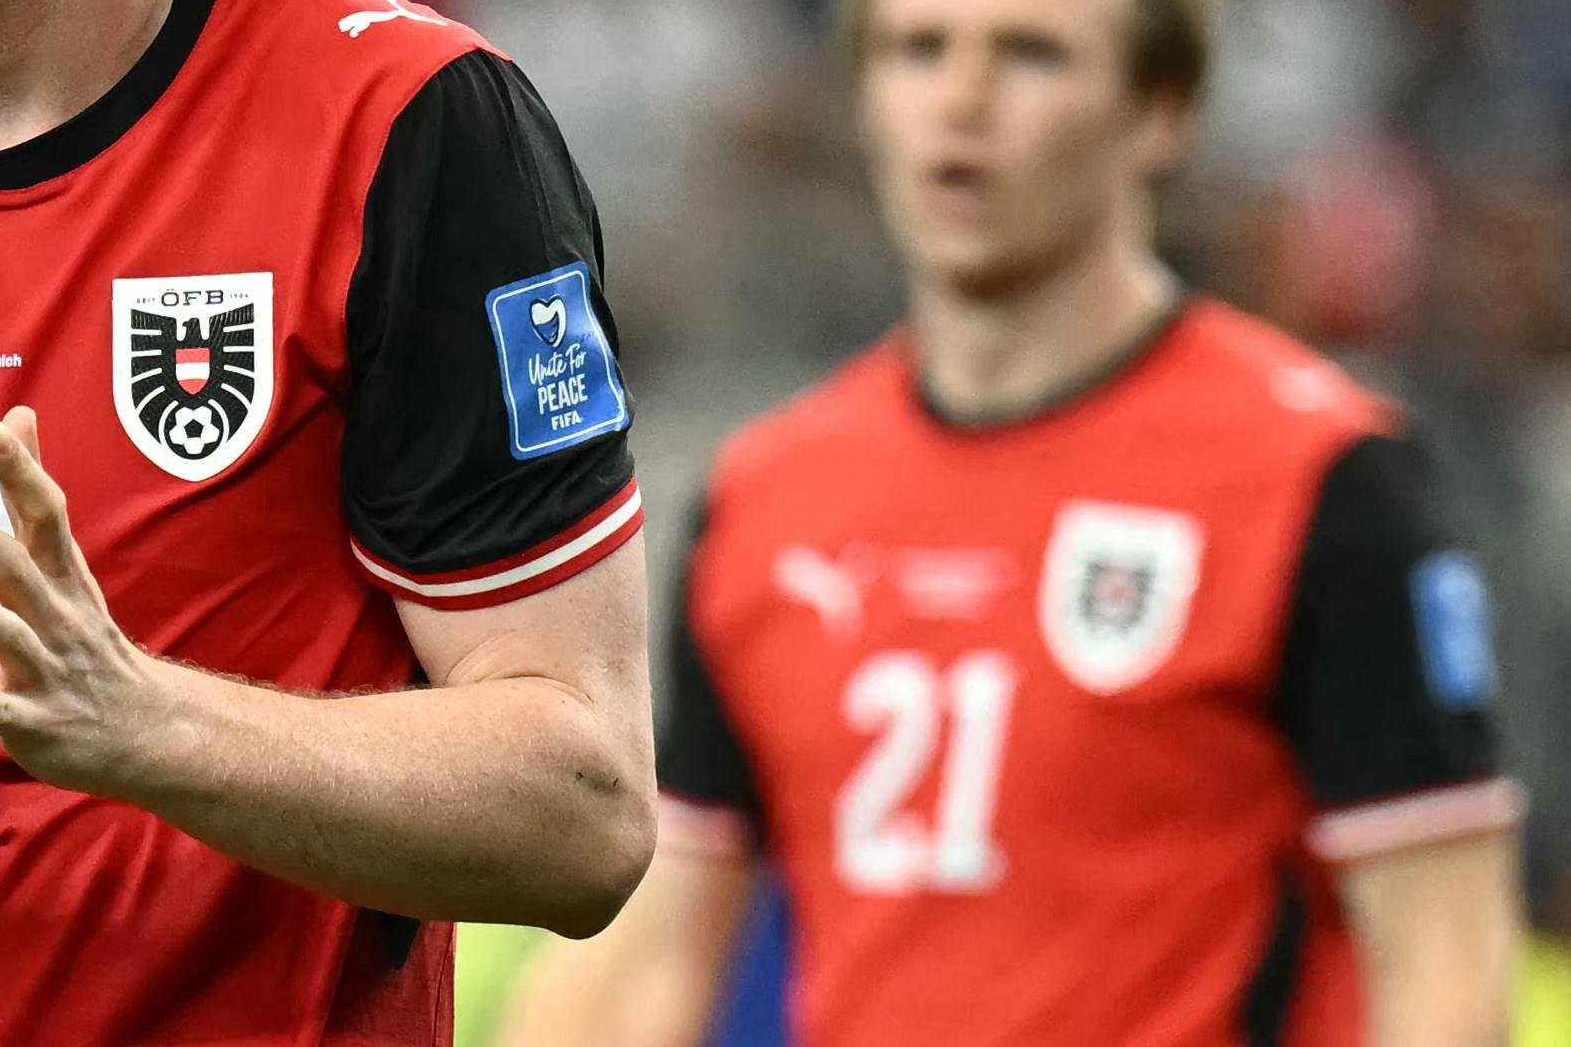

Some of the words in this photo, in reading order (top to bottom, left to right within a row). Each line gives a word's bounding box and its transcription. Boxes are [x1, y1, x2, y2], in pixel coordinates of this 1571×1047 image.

[161, 288, 224, 307] ÖFB
[528, 352, 568, 386] Unite
[565, 343, 587, 375] For
[537, 373, 588, 415] PEACE
[551, 410, 582, 431] FIFA
[836, 653, 1014, 895] 21
